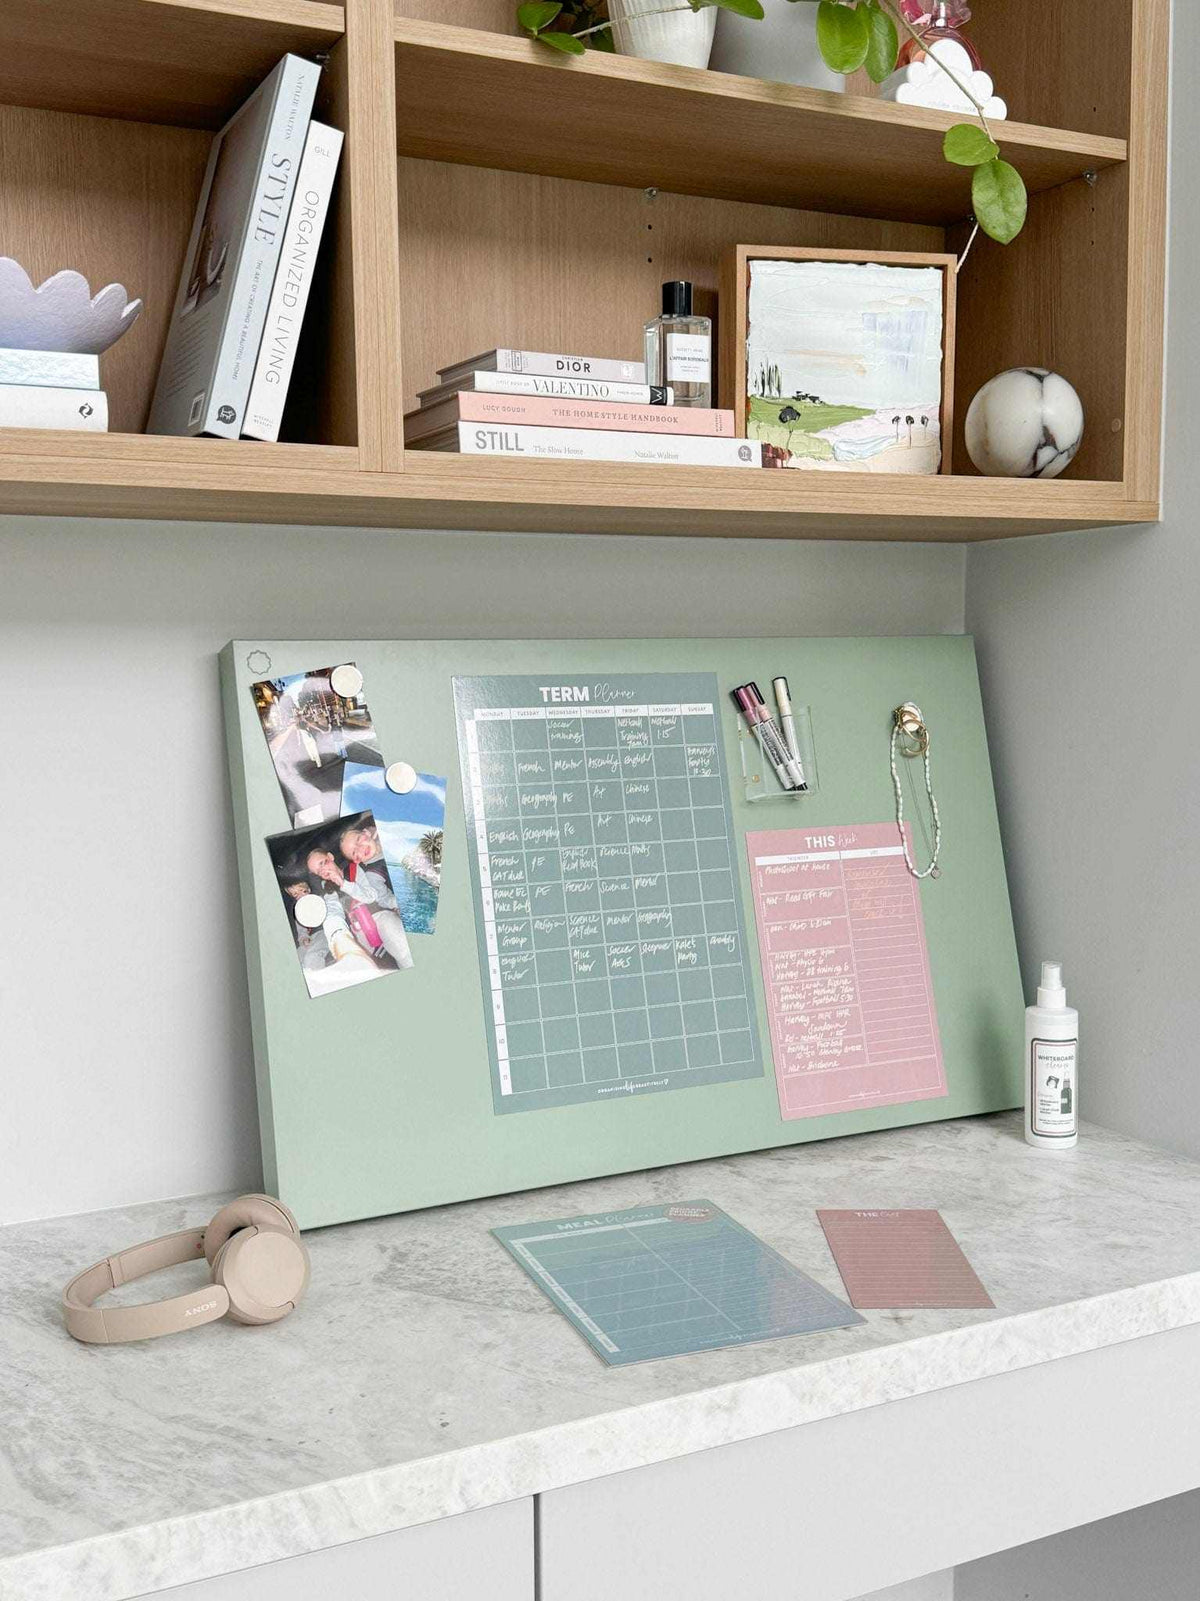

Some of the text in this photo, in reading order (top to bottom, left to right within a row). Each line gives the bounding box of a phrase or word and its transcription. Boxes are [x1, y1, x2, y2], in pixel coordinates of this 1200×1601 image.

[314, 145, 331, 158] GILL
[254, 153, 292, 246] STYLE
[265, 190, 320, 386] ORGANIZED LIVING
[556, 360, 591, 373] DIOR
[533, 379, 610, 398] VALENTINO
[482, 404, 500, 412] LUCY
[552, 409, 571, 417] THE
[631, 413, 679, 423] HANDBOOK
[475, 430, 525, 452] STILL
[634, 449, 656, 459] Natalie
[539, 682, 636, 703] TERM Planner
[804, 835, 836, 849] THIS
[556, 1218, 603, 1231] MEAL
[184, 1300, 217, 1317] SONY
